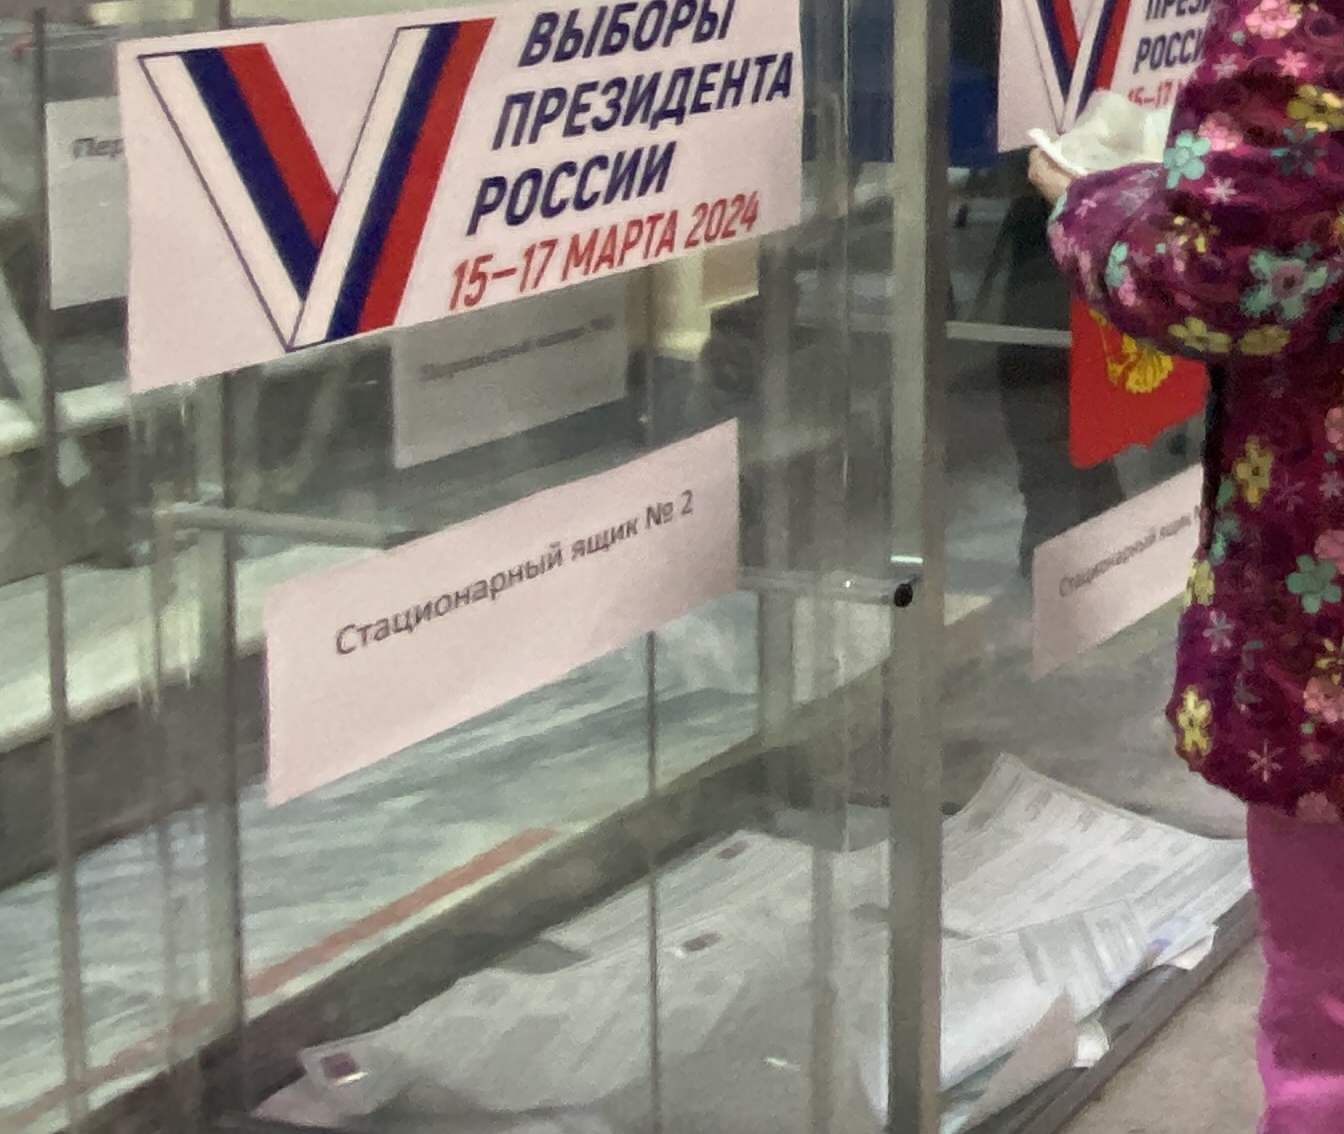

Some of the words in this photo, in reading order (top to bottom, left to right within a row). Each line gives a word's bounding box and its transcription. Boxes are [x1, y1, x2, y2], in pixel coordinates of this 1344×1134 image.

[1134, 28, 1204, 73] РОСС
[490, 51, 794, 151] ПРЕЗИДЕНТА
[465, 141, 677, 237] РОССИИ
[561, 209, 679, 282] МАРТА
[683, 190, 760, 250] 2024
[334, 541, 565, 656] Стационарный
[570, 514, 641, 560] ящик
[644, 499, 676, 530] №
[679, 488, 695, 517] 2
